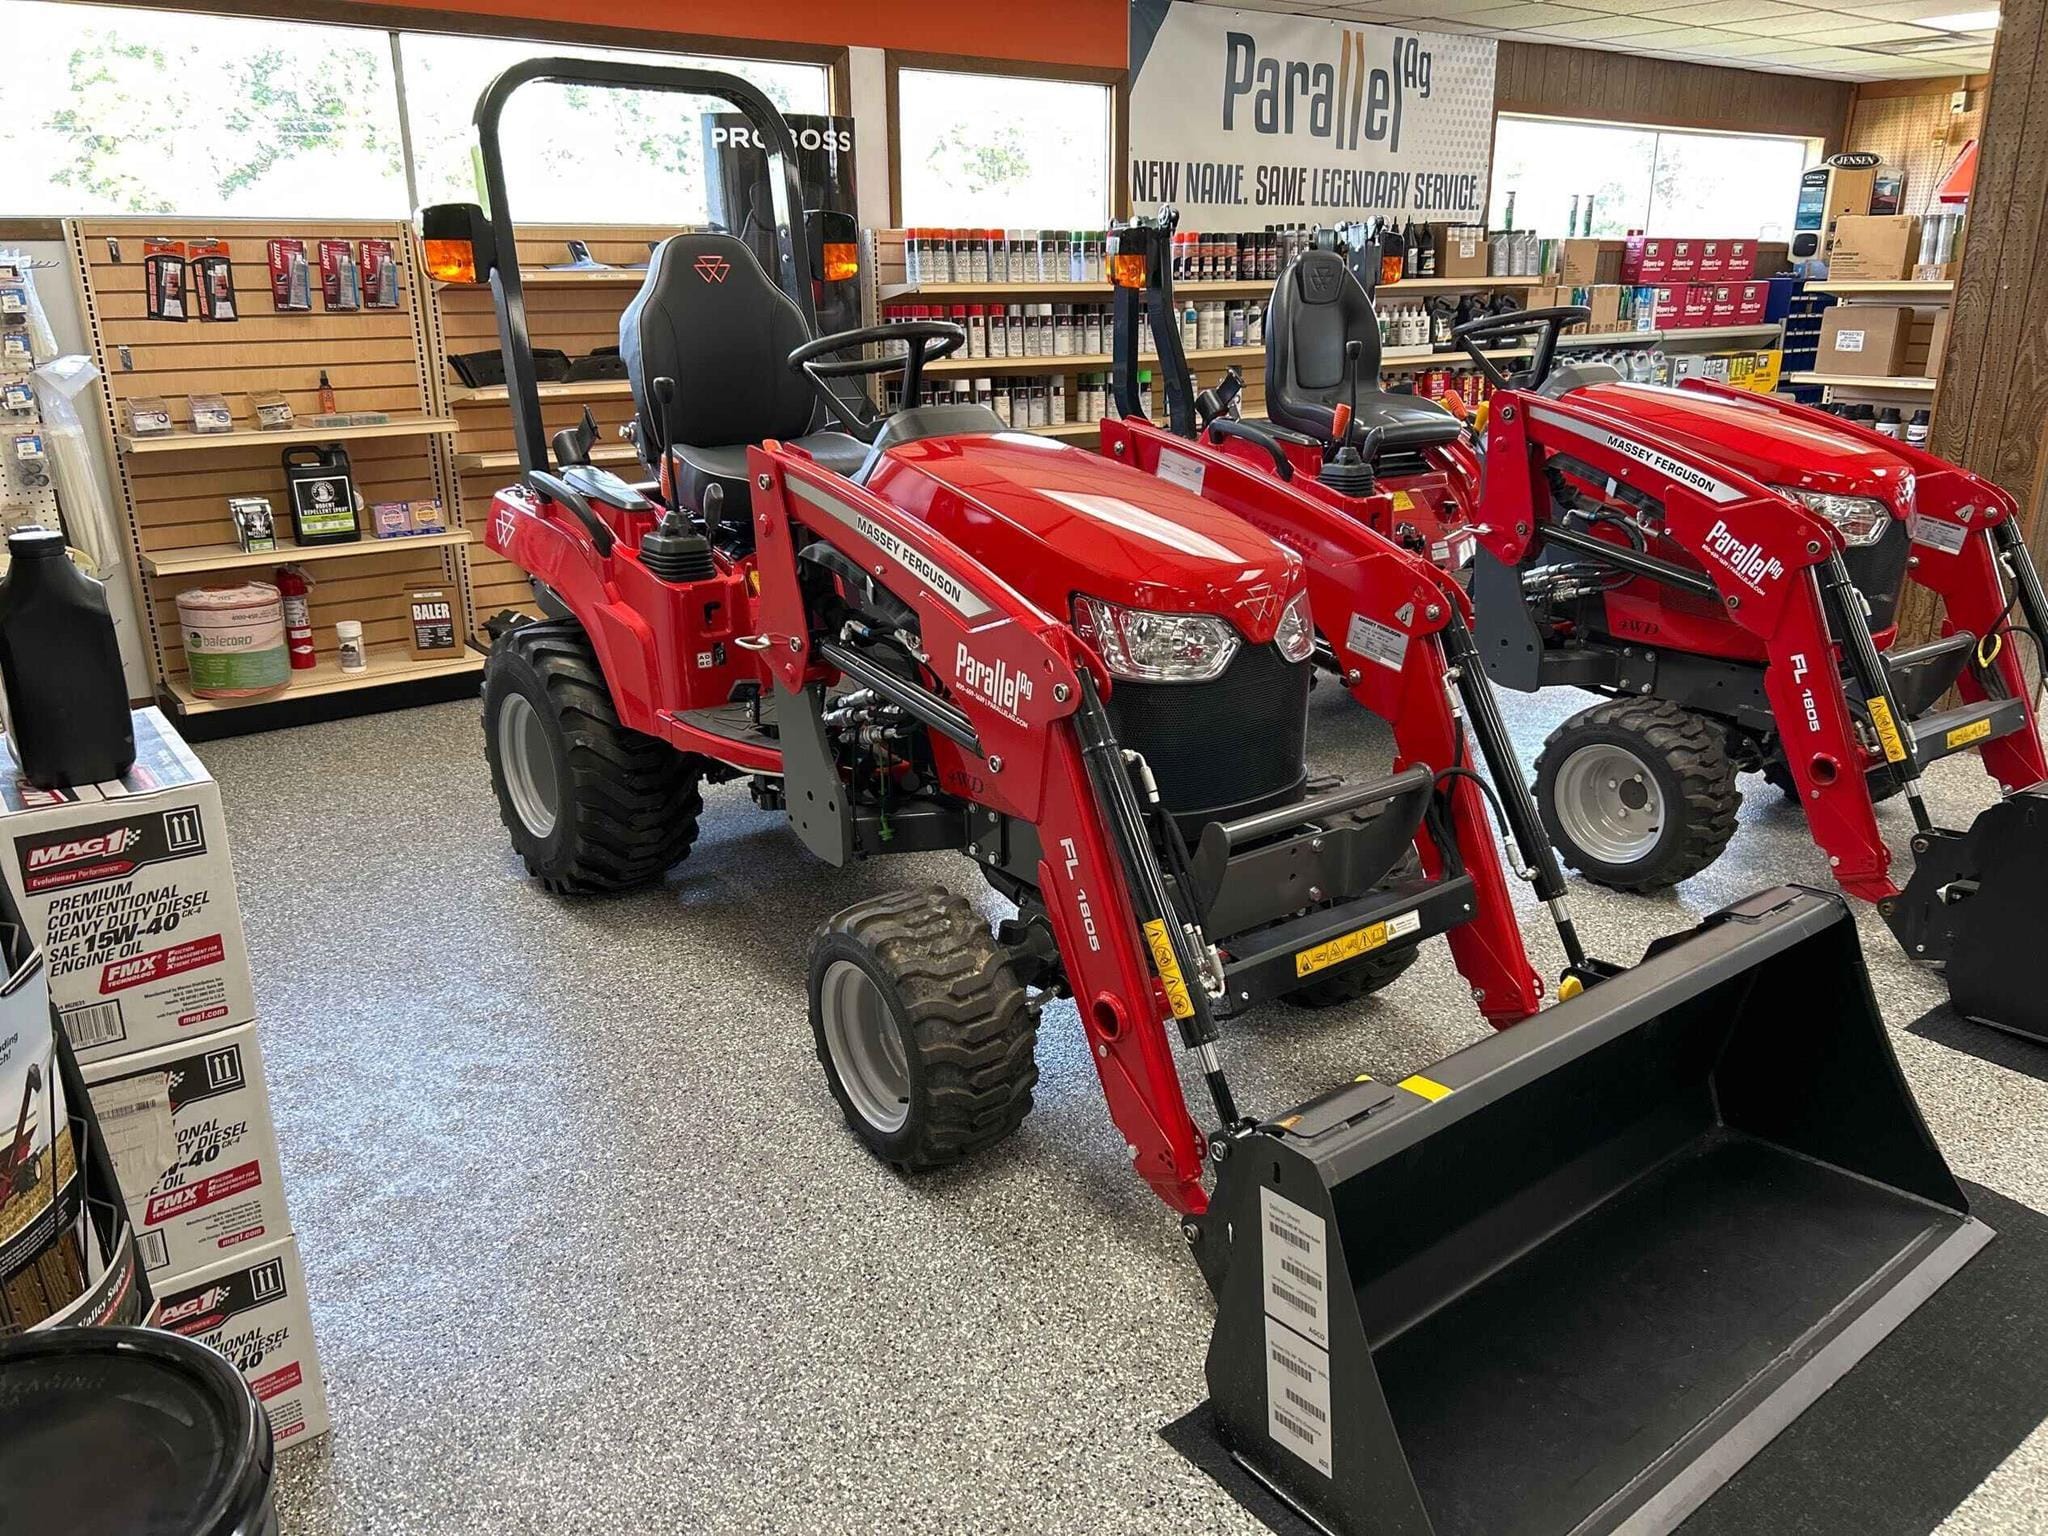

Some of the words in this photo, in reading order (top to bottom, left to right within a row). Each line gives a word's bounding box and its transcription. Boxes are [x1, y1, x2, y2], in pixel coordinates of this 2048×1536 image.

[1223, 30, 1403, 153] Parallel
[1404, 38, 1432, 98] Ag
[1836, 156, 1874, 165] JENSEN
[1133, 160, 1180, 203] NEW
[1186, 162, 1248, 206] NAME.
[1256, 165, 1308, 206] SAME
[1311, 168, 1411, 210] LEGENDARY
[1414, 173, 1481, 211] SERVICE.
[273, 243, 282, 269] LOCTITE
[321, 244, 331, 270] LOCTITE
[362, 244, 371, 269] LOCTITE
[1607, 436, 1654, 463] MASSEY
[1654, 456, 1716, 494] FERGUSON
[857, 517, 900, 555] MASSEY
[902, 548, 961, 602] FERGUSON
[1705, 519, 1775, 585] Parallel
[1767, 560, 1784, 580] Ag
[412, 603, 450, 620] BALER
[955, 642, 1021, 715] Parallel
[1020, 673, 1033, 700] Ag
[1790, 654, 1809, 683] FL
[1801, 688, 1820, 732] 1805
[29, 828, 126, 869] MAG1
[33, 871, 77, 887] Evolutionary
[78, 864, 119, 879] Performance
[47, 885, 180, 930] CONVENTIONAL
[48, 881, 133, 915] PREMIUM
[1059, 837, 1081, 881] FL
[1077, 888, 1101, 952] 1805
[46, 920, 102, 946] HEAVY
[107, 907, 152, 930] DUTY
[155, 891, 210, 916] DIESEL
[49, 943, 79, 962] SAE
[84, 912, 180, 952] 15W-40
[181, 908, 201, 918] CK-4
[50, 954, 114, 977] ENGINE
[119, 941, 144, 958] OIL
[108, 956, 158, 981] FMX
[108, 969, 156, 988] TECHNOLOGY
[183, 1008, 225, 1024] mag1.com
[0, 1032, 18, 1053] ding
[199, 1121, 248, 1149] DIESEL
[222, 1136, 240, 1149] CK-4
[163, 1173, 187, 1191] OIL
[152, 1186, 199, 1213] FMX
[153, 1200, 197, 1219] TECHNOLOGY
[222, 1228, 262, 1246] mag1.com
[242, 1328, 289, 1357] DIESEL
[265, 1342, 282, 1354] CK-4
